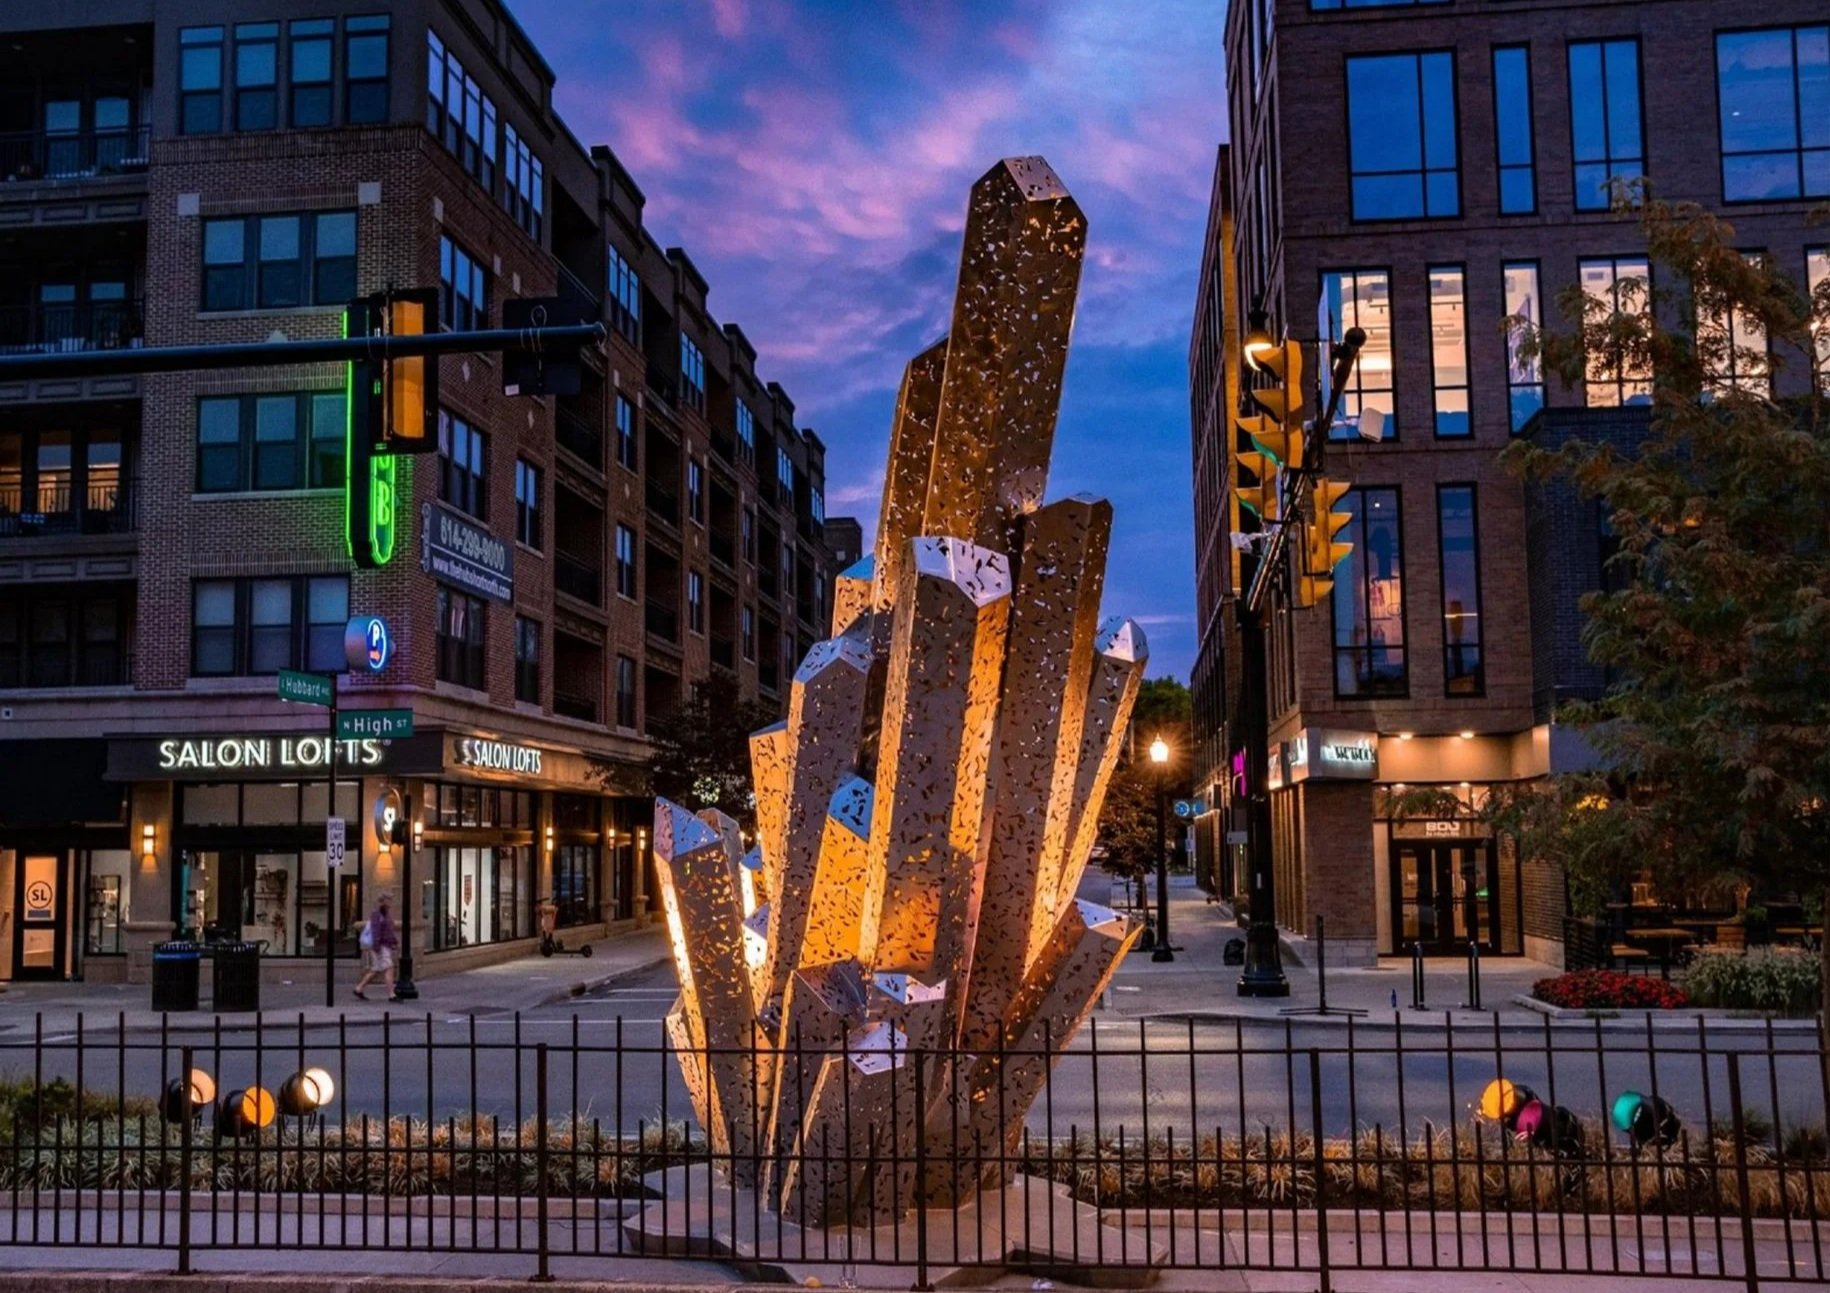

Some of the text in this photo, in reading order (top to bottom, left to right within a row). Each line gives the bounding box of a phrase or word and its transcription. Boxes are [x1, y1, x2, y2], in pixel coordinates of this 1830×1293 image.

[286, 677, 320, 697] Hubbard
[343, 717, 407, 735] N High ST
[159, 739, 269, 768] SALON
[473, 740, 541, 774] SALON LOFTS
[328, 843, 344, 860] 30
[32, 889, 47, 902] SL
